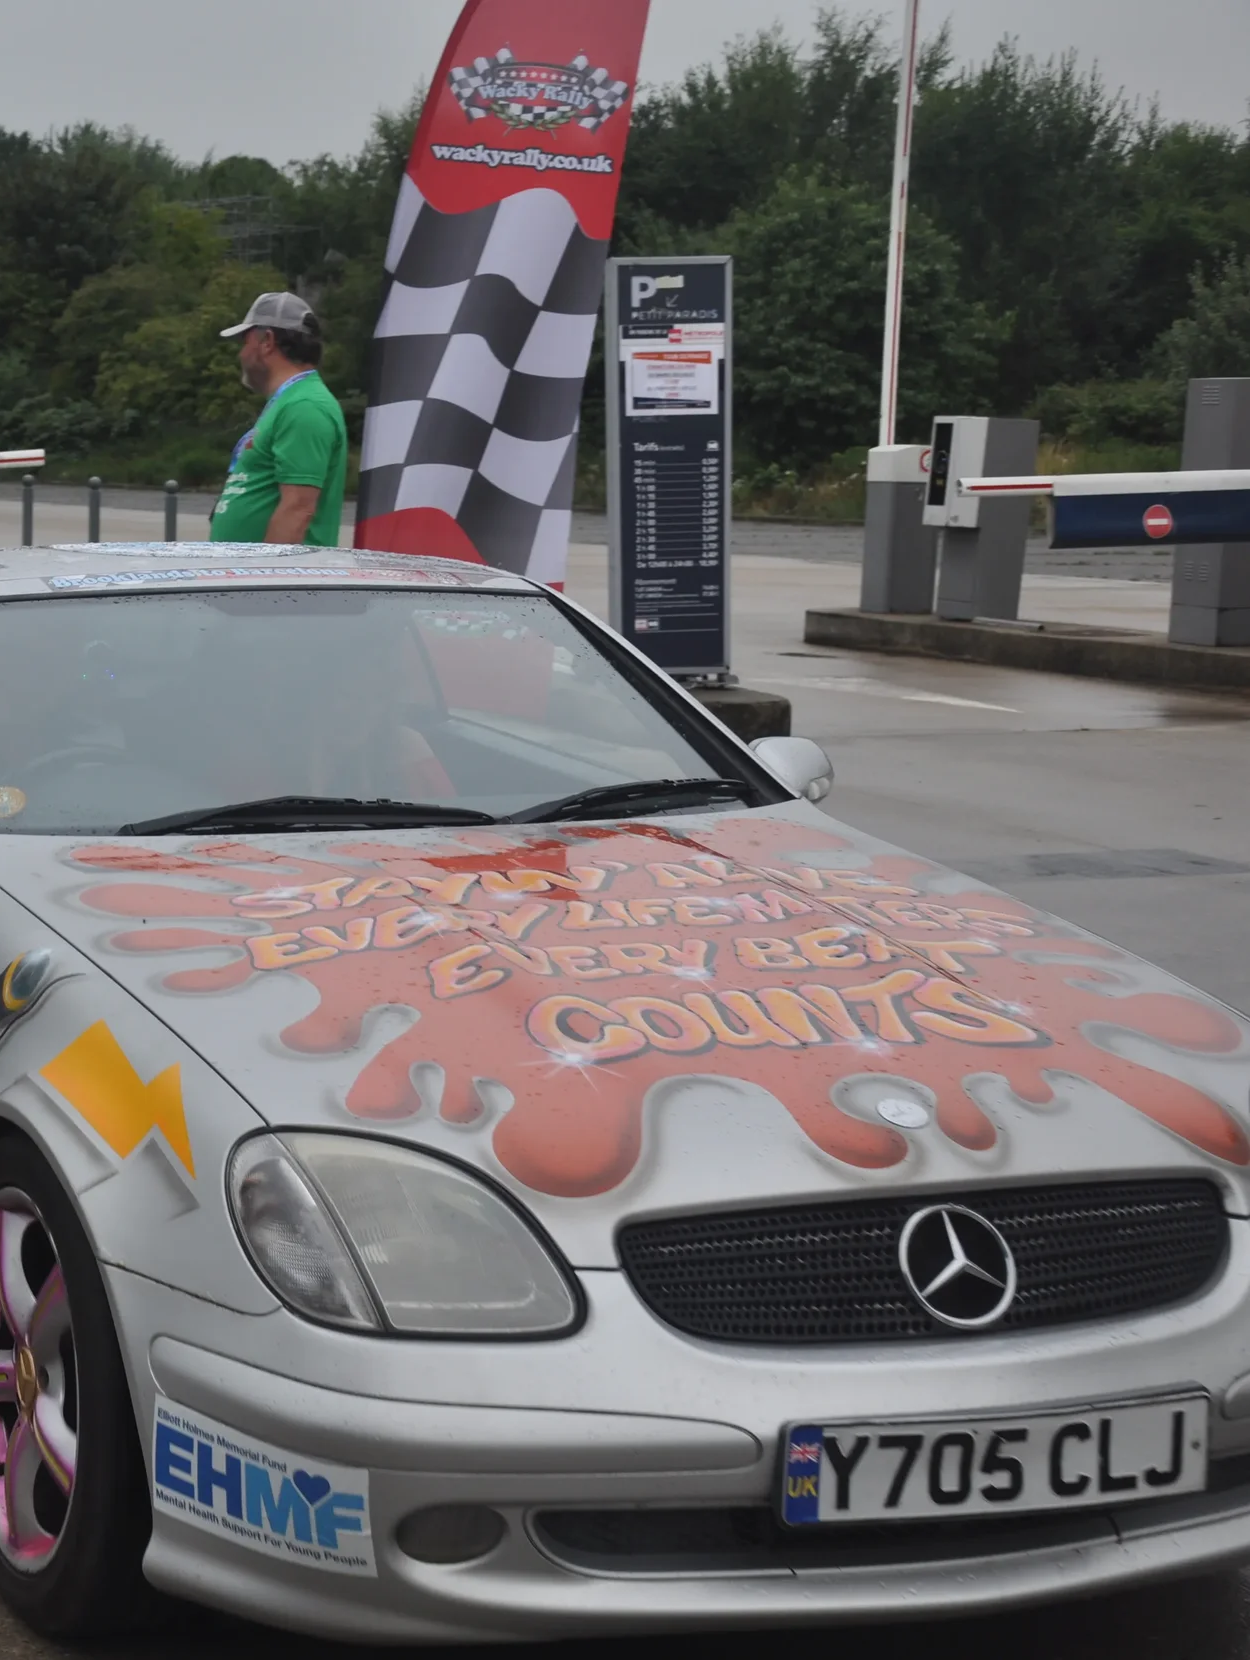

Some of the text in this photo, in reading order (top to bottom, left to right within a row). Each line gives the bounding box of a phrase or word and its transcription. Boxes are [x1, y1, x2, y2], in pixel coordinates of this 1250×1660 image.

[478, 84, 594, 110] Wacky Rally
[431, 144, 614, 173] wackyrally.co.uk
[631, 276, 657, 307] P
[633, 442, 658, 452] Tarifs
[50, 569, 197, 588] Brooklands
[230, 567, 350, 577] Barcelona
[245, 902, 553, 971] EVERY
[558, 897, 737, 929] LIFE
[426, 924, 1005, 999] EVERY BEAT
[525, 969, 1052, 1064] COUNTS
[157, 1407, 287, 1474] Elliott Holmes Memorial Fund
[822, 1410, 1186, 1512] Y705 CLJ
[155, 1421, 365, 1550] EHMF
[787, 1475, 818, 1498] UK
[156, 1488, 368, 1567] Mental Health Support For Young People
